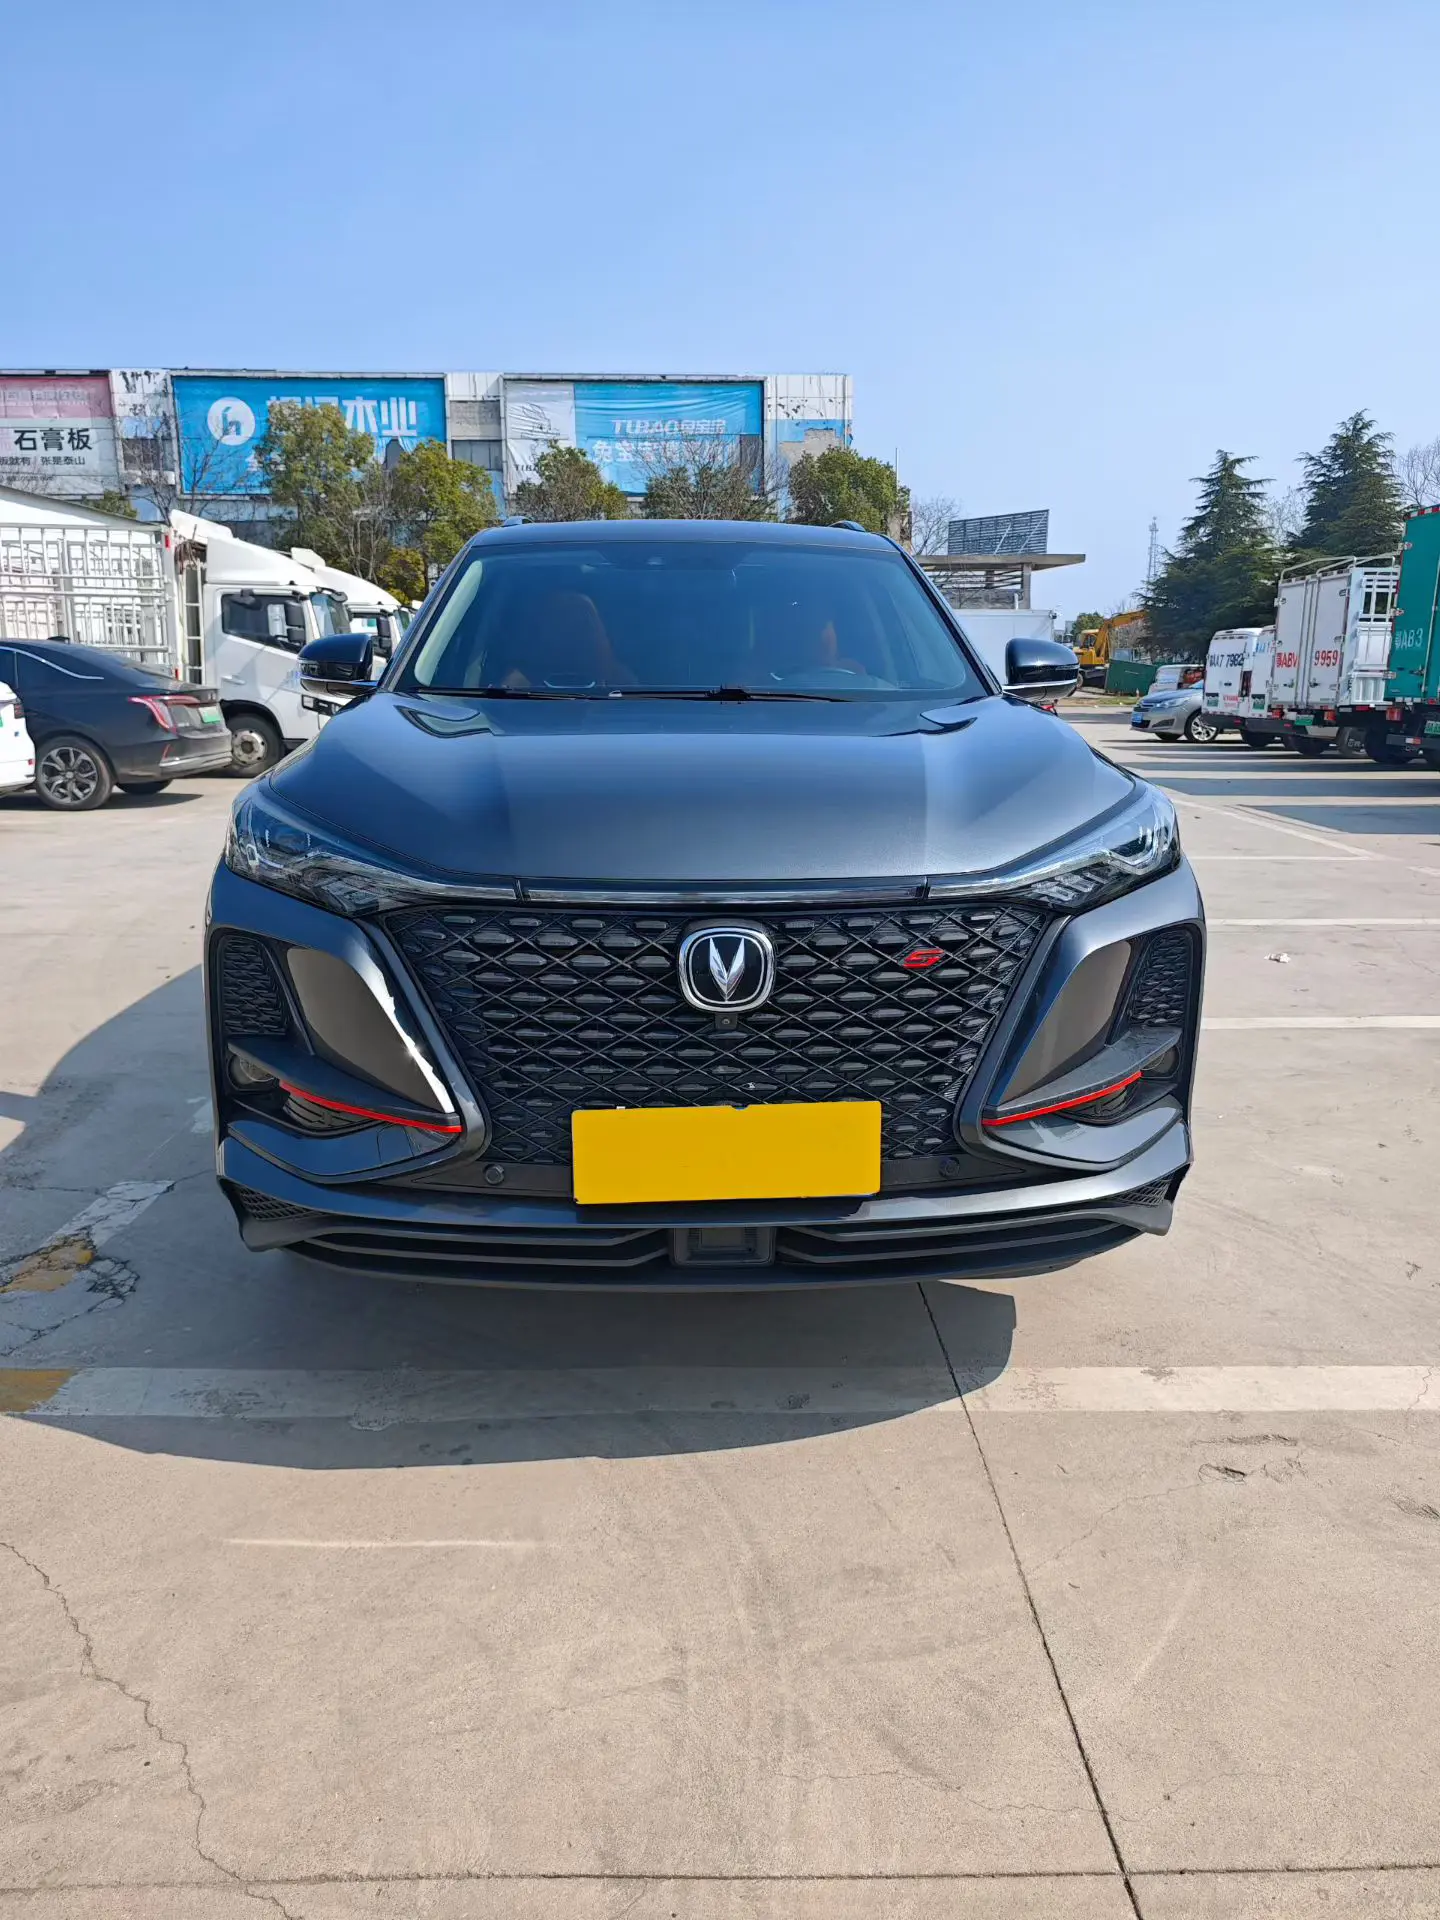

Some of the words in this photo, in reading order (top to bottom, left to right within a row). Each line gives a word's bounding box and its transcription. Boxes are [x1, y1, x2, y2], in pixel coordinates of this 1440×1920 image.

[266, 396, 417, 437] 木业
[14, 428, 92, 451] 石膏板
[1314, 650, 1338, 667] 9959
